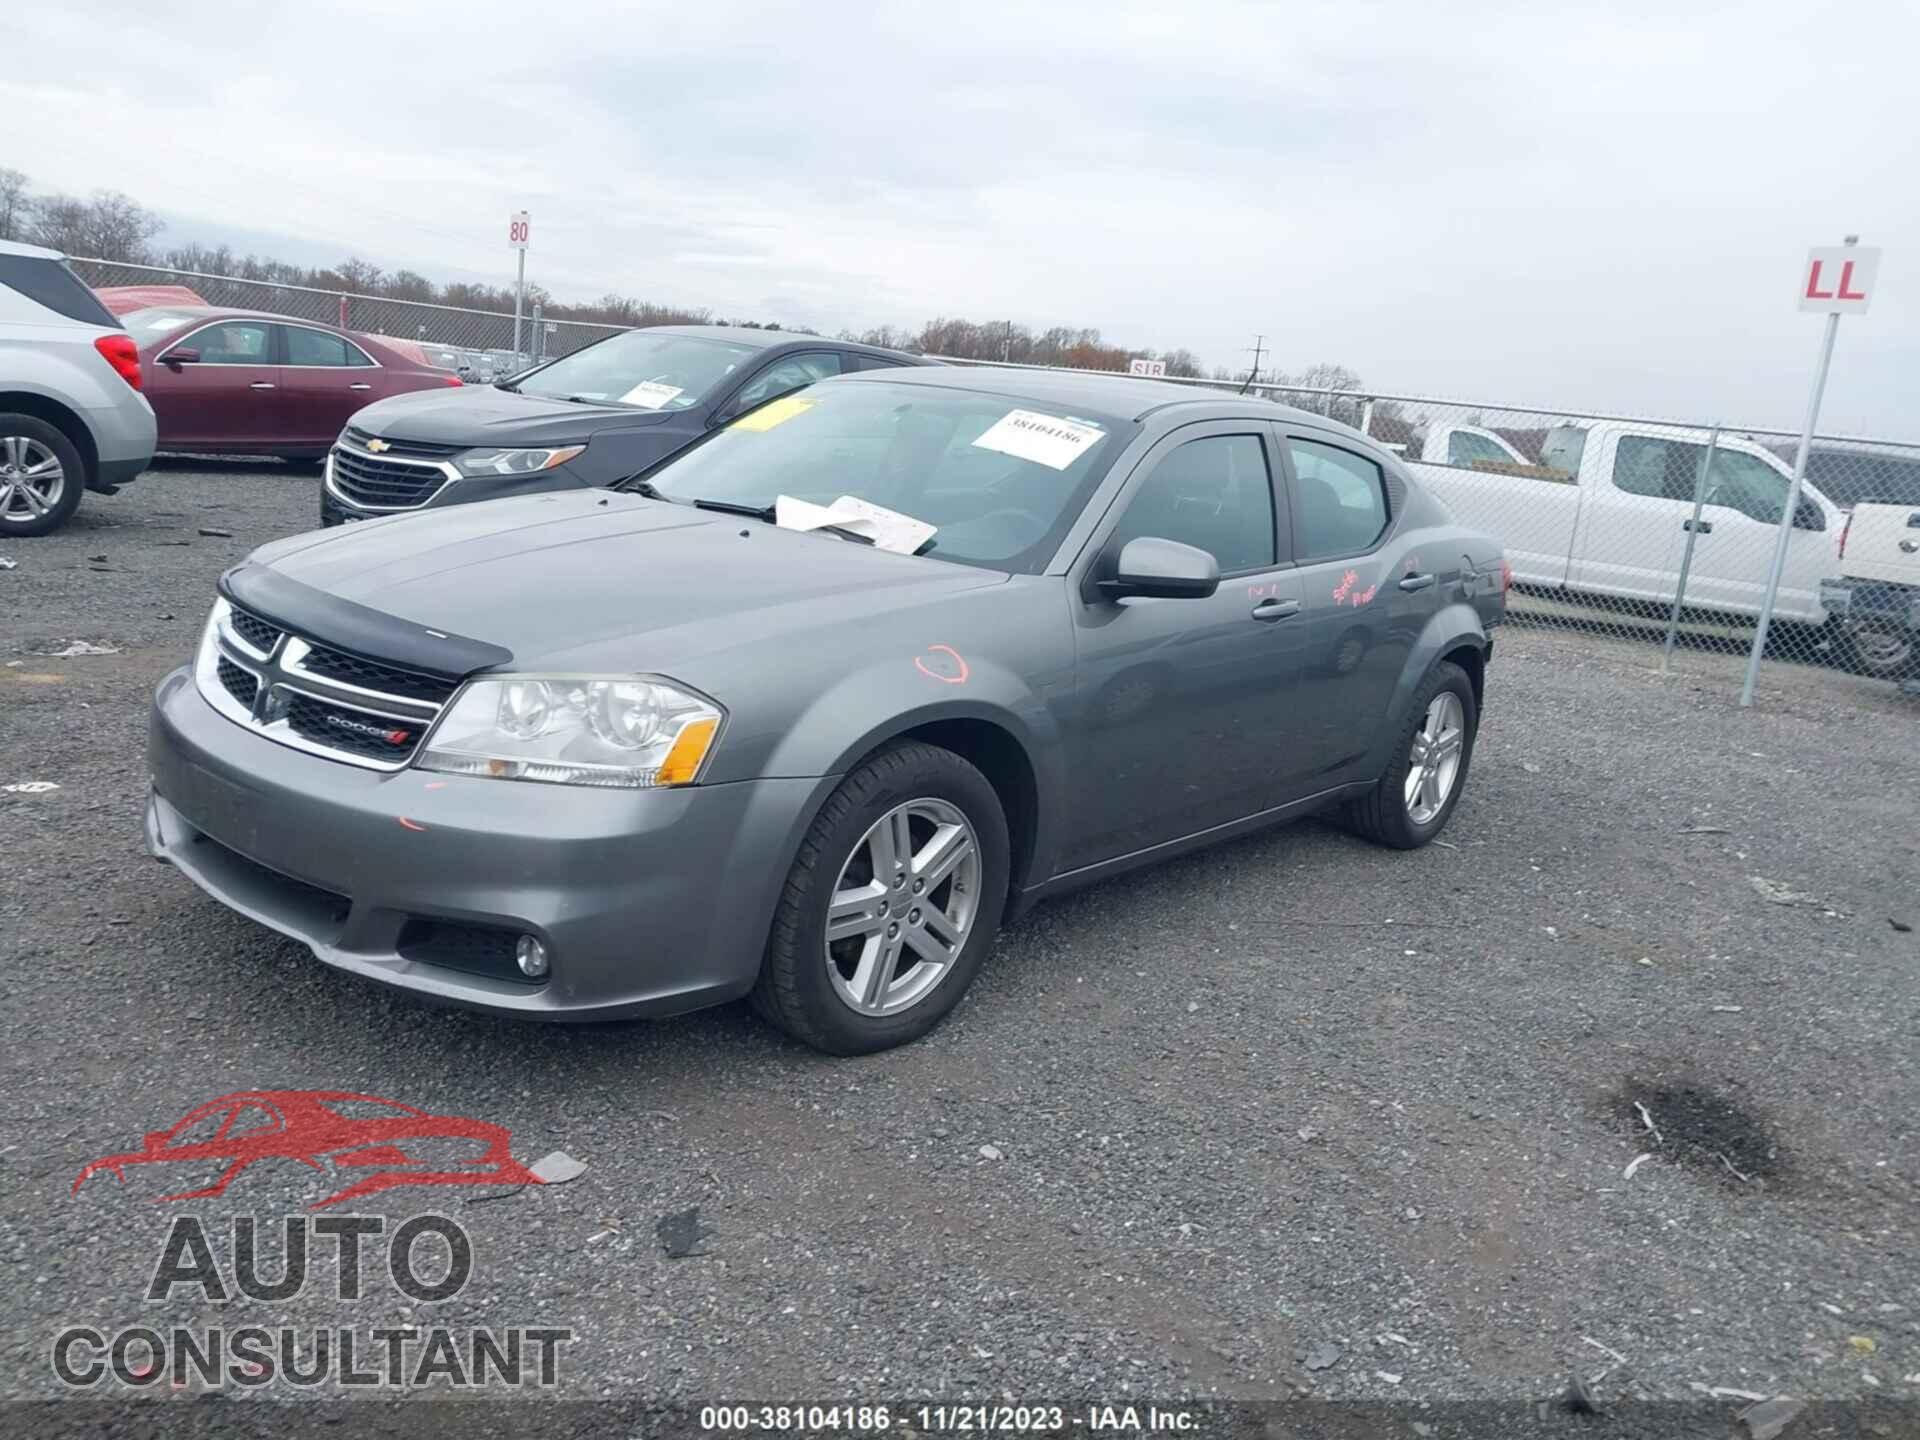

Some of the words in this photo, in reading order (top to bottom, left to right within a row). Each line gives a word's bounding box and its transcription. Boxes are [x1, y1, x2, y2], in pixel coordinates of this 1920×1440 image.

[510, 222, 528, 241] 80
[1806, 260, 1865, 299] LL
[327, 716, 391, 737] DODGE
